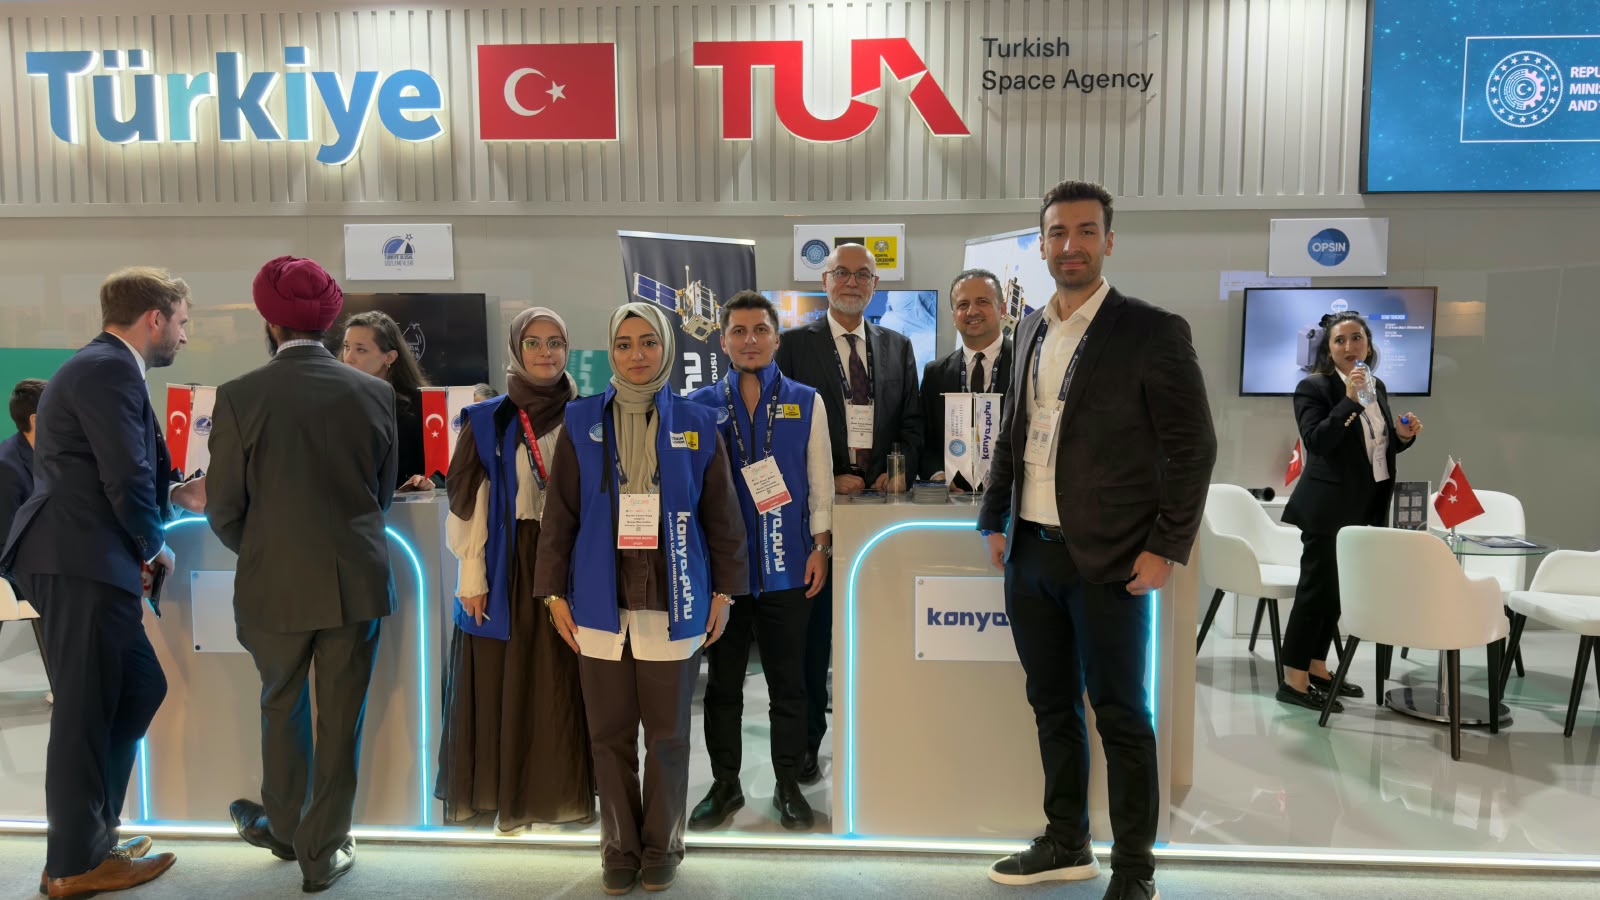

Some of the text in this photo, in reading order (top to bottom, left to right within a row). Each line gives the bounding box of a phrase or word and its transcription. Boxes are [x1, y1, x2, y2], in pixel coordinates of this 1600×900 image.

[982, 37, 1070, 58] Turkish
[693, 37, 971, 142] TUA
[982, 69, 1154, 95] Space Agency
[1569, 83, 1600, 95] MINI
[26, 46, 443, 165] Türkiye
[1568, 100, 1598, 111] AND
[1311, 242, 1346, 252] OPSIN
[981, 401, 992, 460] konya.puhu
[769, 506, 786, 572] ya.puhu
[676, 511, 693, 620] konya.puhu
[927, 608, 1010, 632] konya
